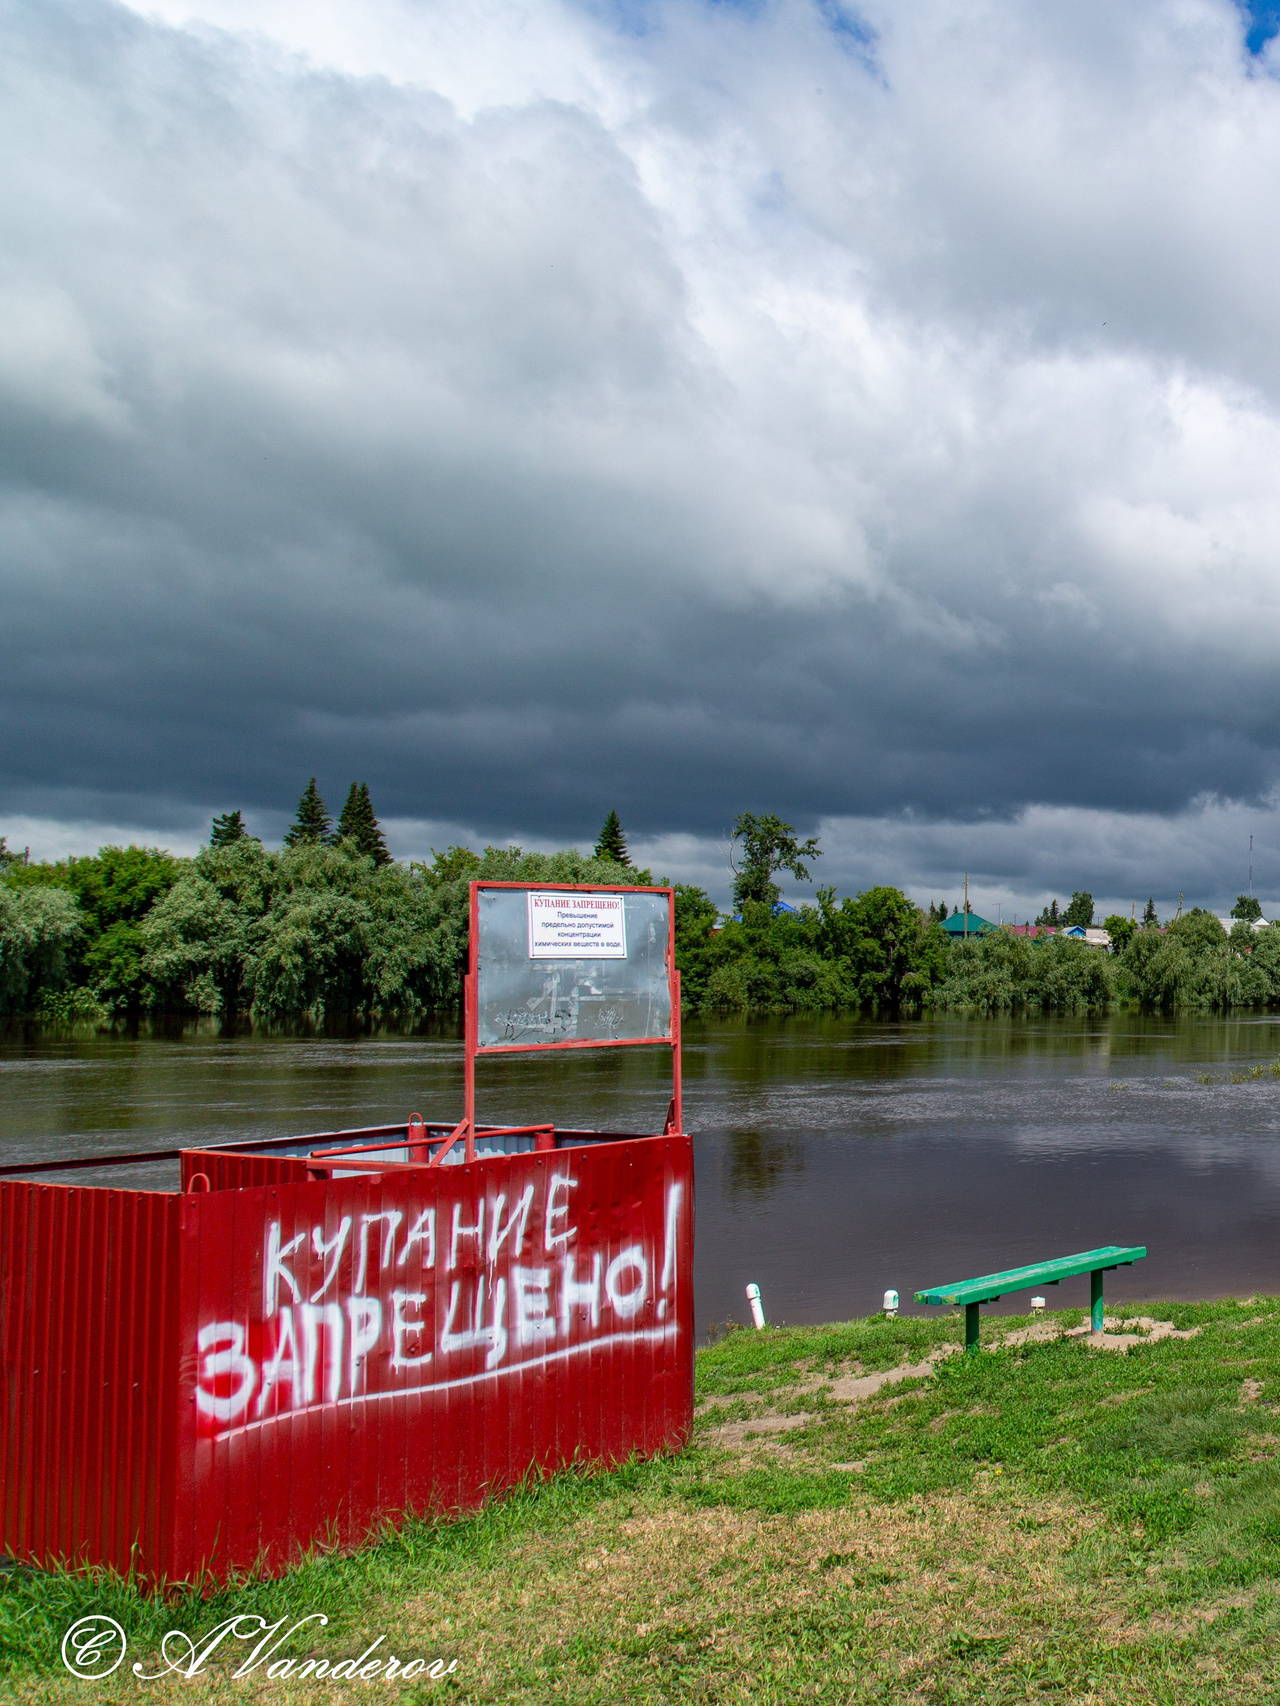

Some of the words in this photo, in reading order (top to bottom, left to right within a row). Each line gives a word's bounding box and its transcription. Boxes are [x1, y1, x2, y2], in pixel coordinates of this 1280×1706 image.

[534, 898, 571, 909] КУПАНИЕ
[572, 900, 620, 910] ЗАПРЕЩЕНО!
[557, 911, 598, 919] Превышение
[577, 921, 614, 930] допустимой
[265, 1173, 578, 1317] КУПАНИЕ
[196, 1182, 684, 1422] ЗАПРЕЩЕНО!
